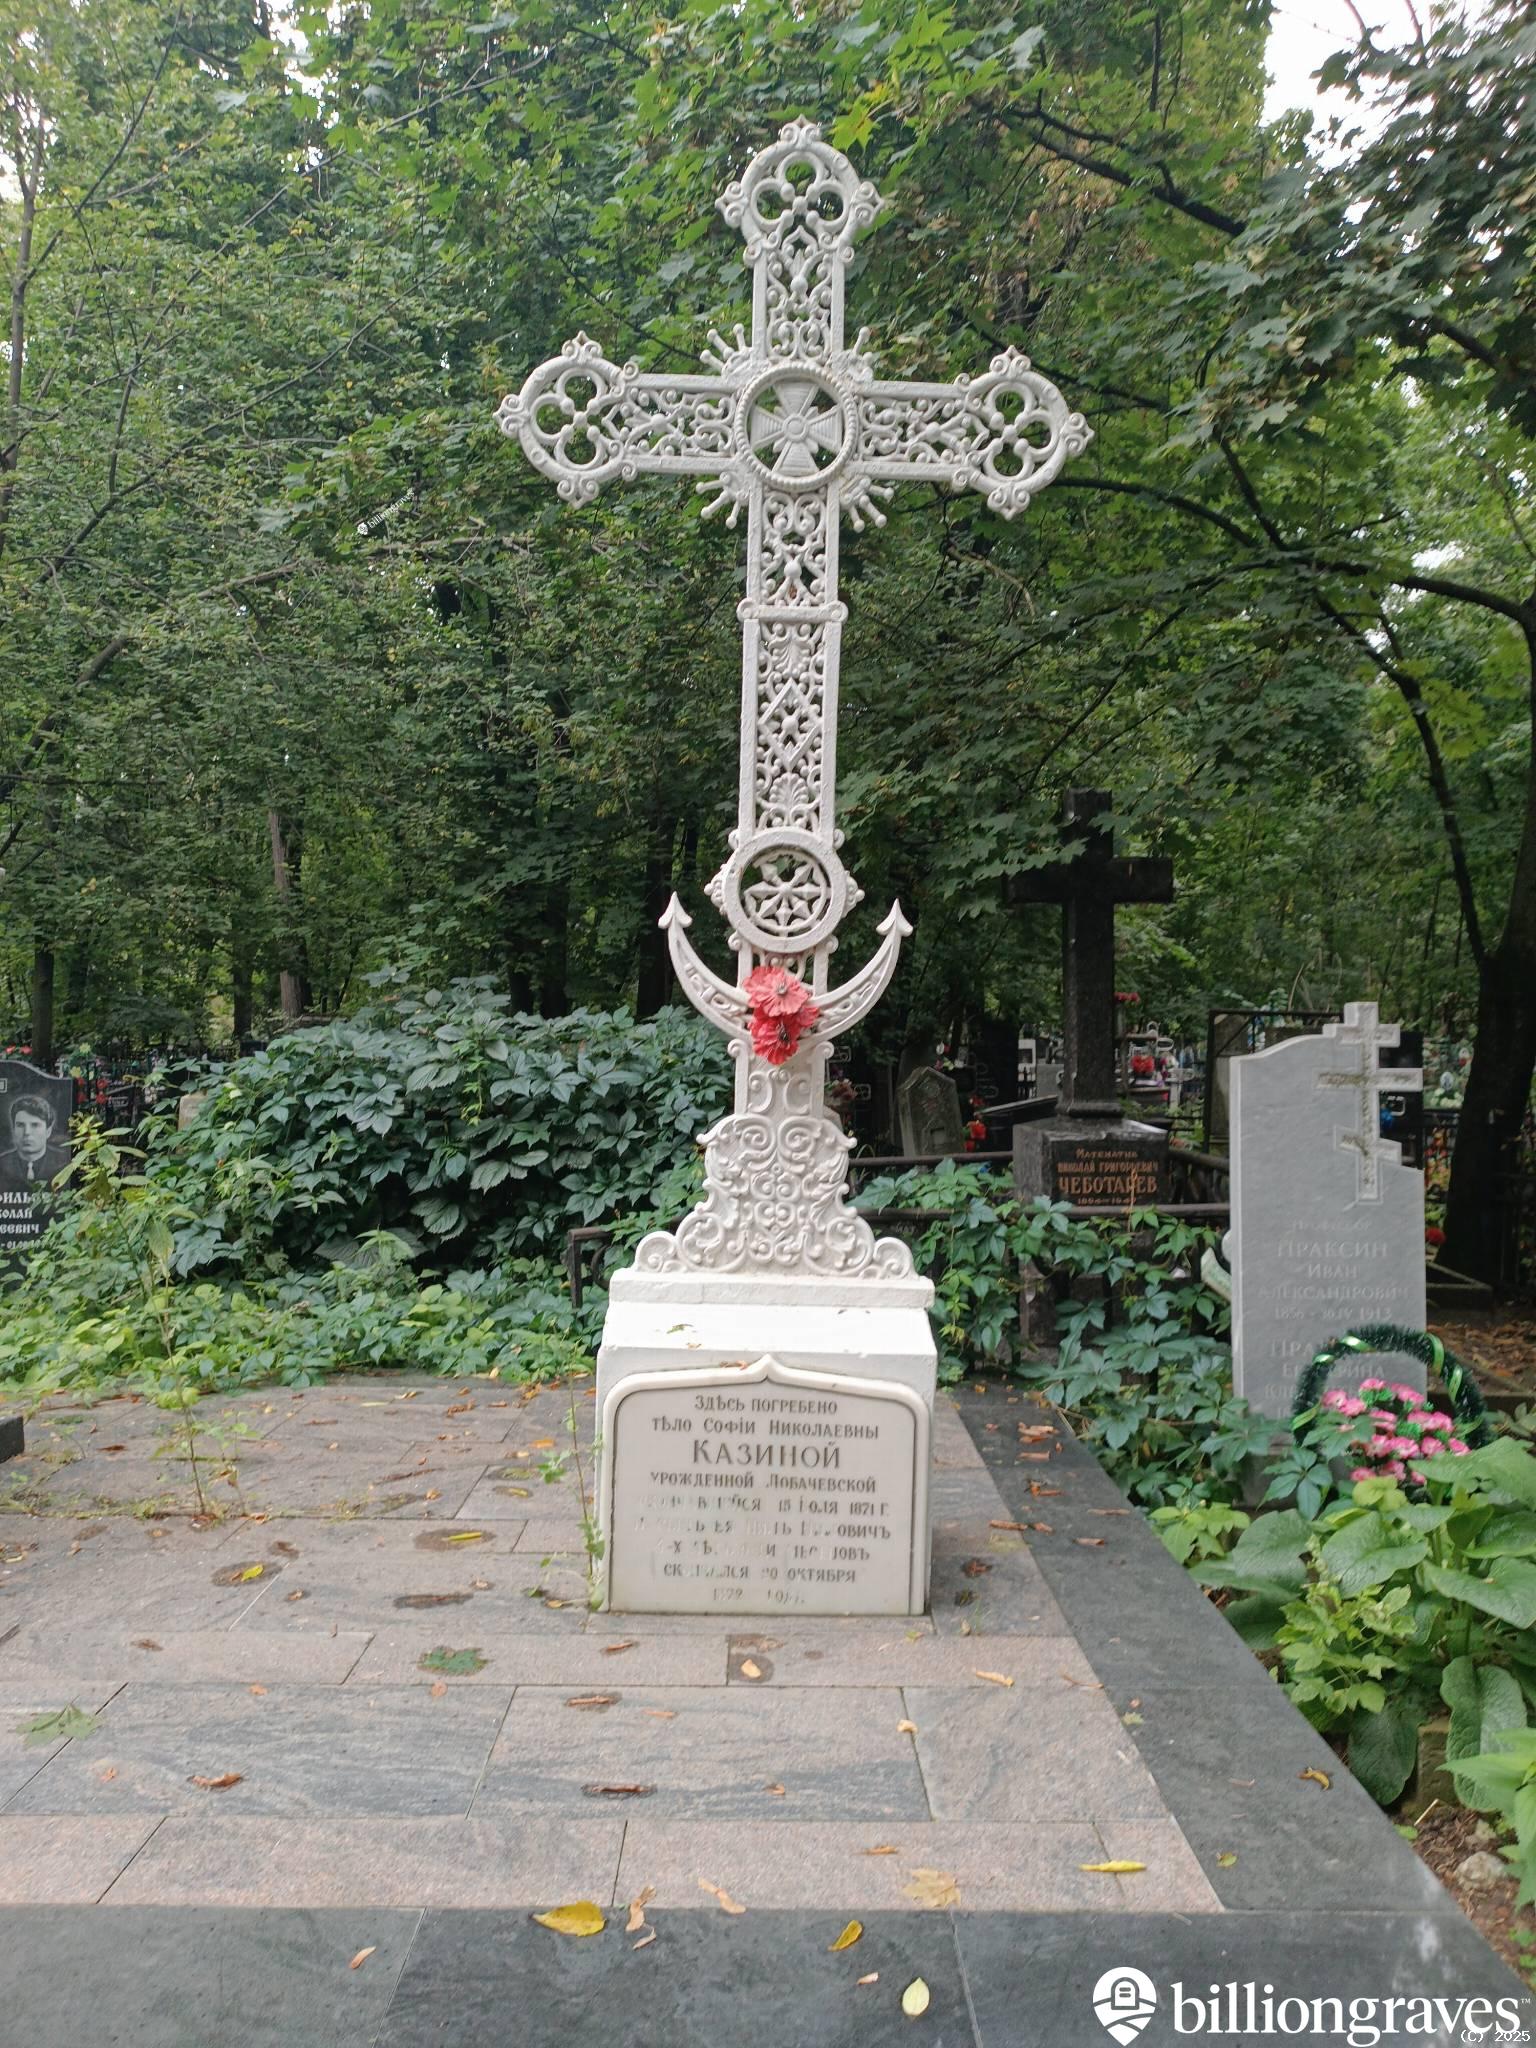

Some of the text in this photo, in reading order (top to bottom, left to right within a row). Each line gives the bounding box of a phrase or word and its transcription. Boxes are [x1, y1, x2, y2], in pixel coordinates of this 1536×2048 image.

[1059, 1176, 1158, 1194] ЧЕБОТАРЕВ
[0, 1208, 33, 1219] ОЛАЙ
[1277, 1240, 1388, 1258] ПРАКСИН
[1308, 1263, 1361, 1279] ИВАН
[751, 1398, 839, 1416] ПОГРЕБЕНО
[769, 1419, 880, 1441] НИКОЛАЕВНЫ
[692, 1438, 841, 1470] КАЗИНОЙ
[650, 1471, 877, 1493] УРОЖДЕННОЙ ЛОБАЧЕВСКОЙ
[786, 1567, 857, 1584] ОКТЯБРЯ
